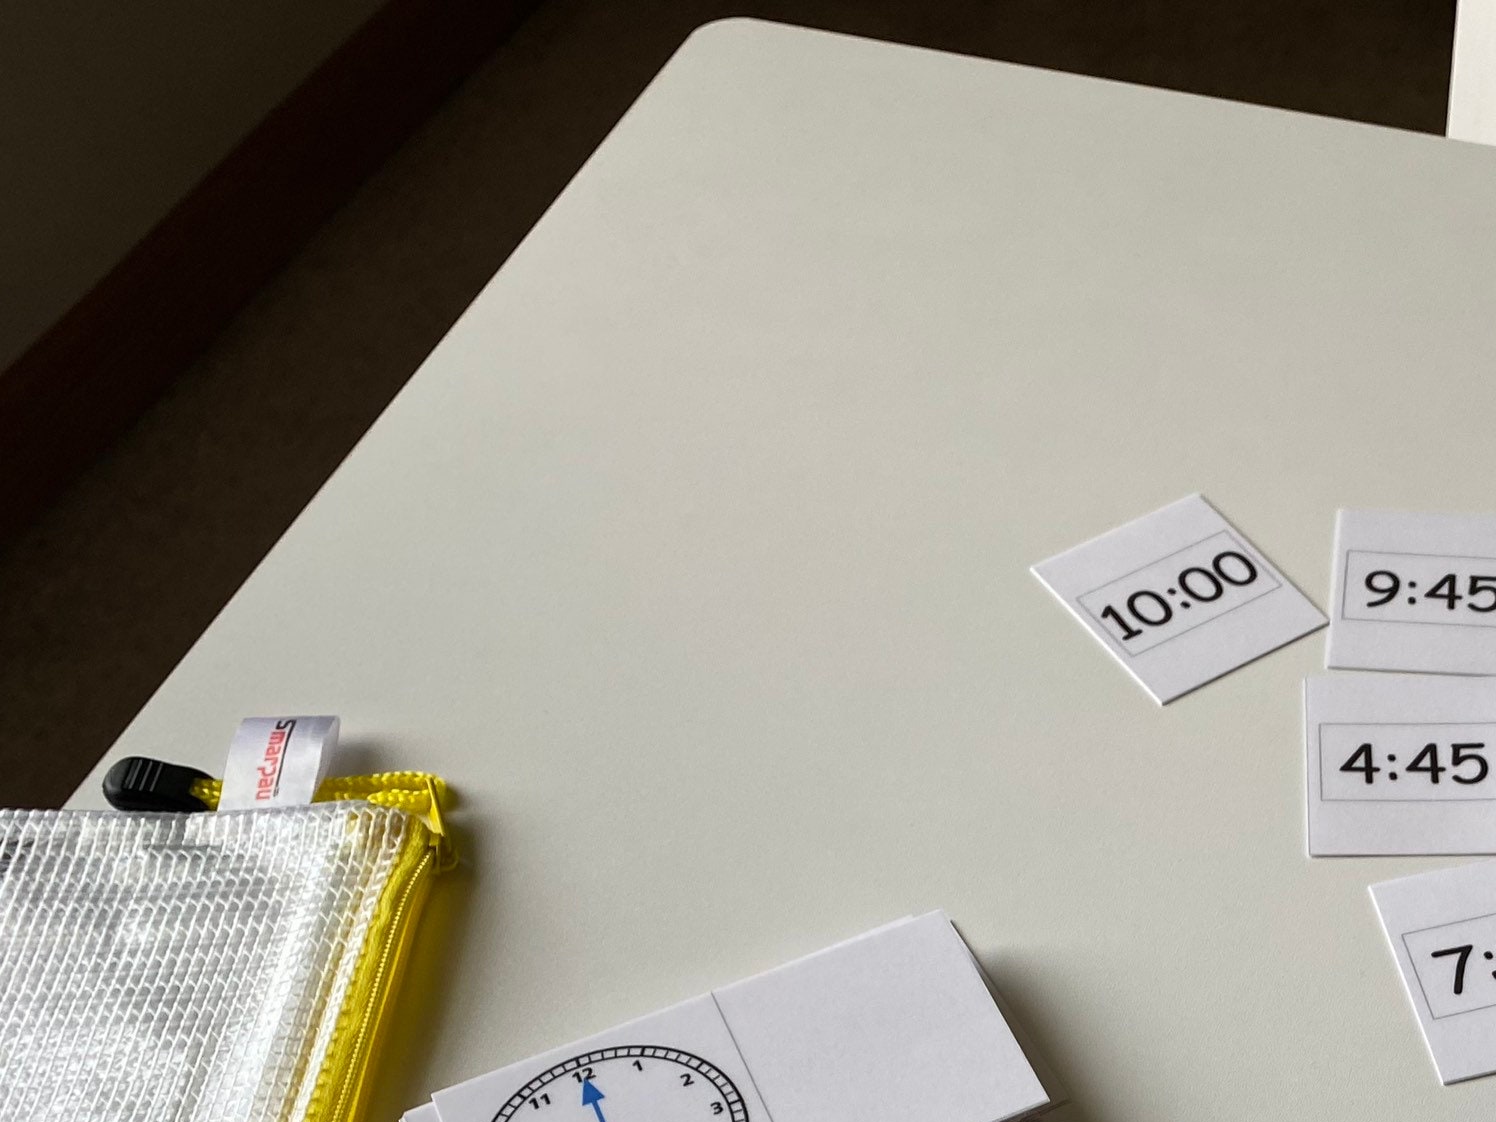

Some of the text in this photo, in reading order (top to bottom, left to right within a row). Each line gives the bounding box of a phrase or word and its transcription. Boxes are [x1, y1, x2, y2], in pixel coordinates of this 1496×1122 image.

[1101, 551, 1258, 641] 10:00
[1339, 742, 1489, 785] 4:45
[633, 1060, 642, 1071] 1
[572, 1067, 597, 1084] 12
[680, 1074, 694, 1086] 2
[529, 1093, 552, 1110] 11
[710, 1101, 724, 1115] 3
